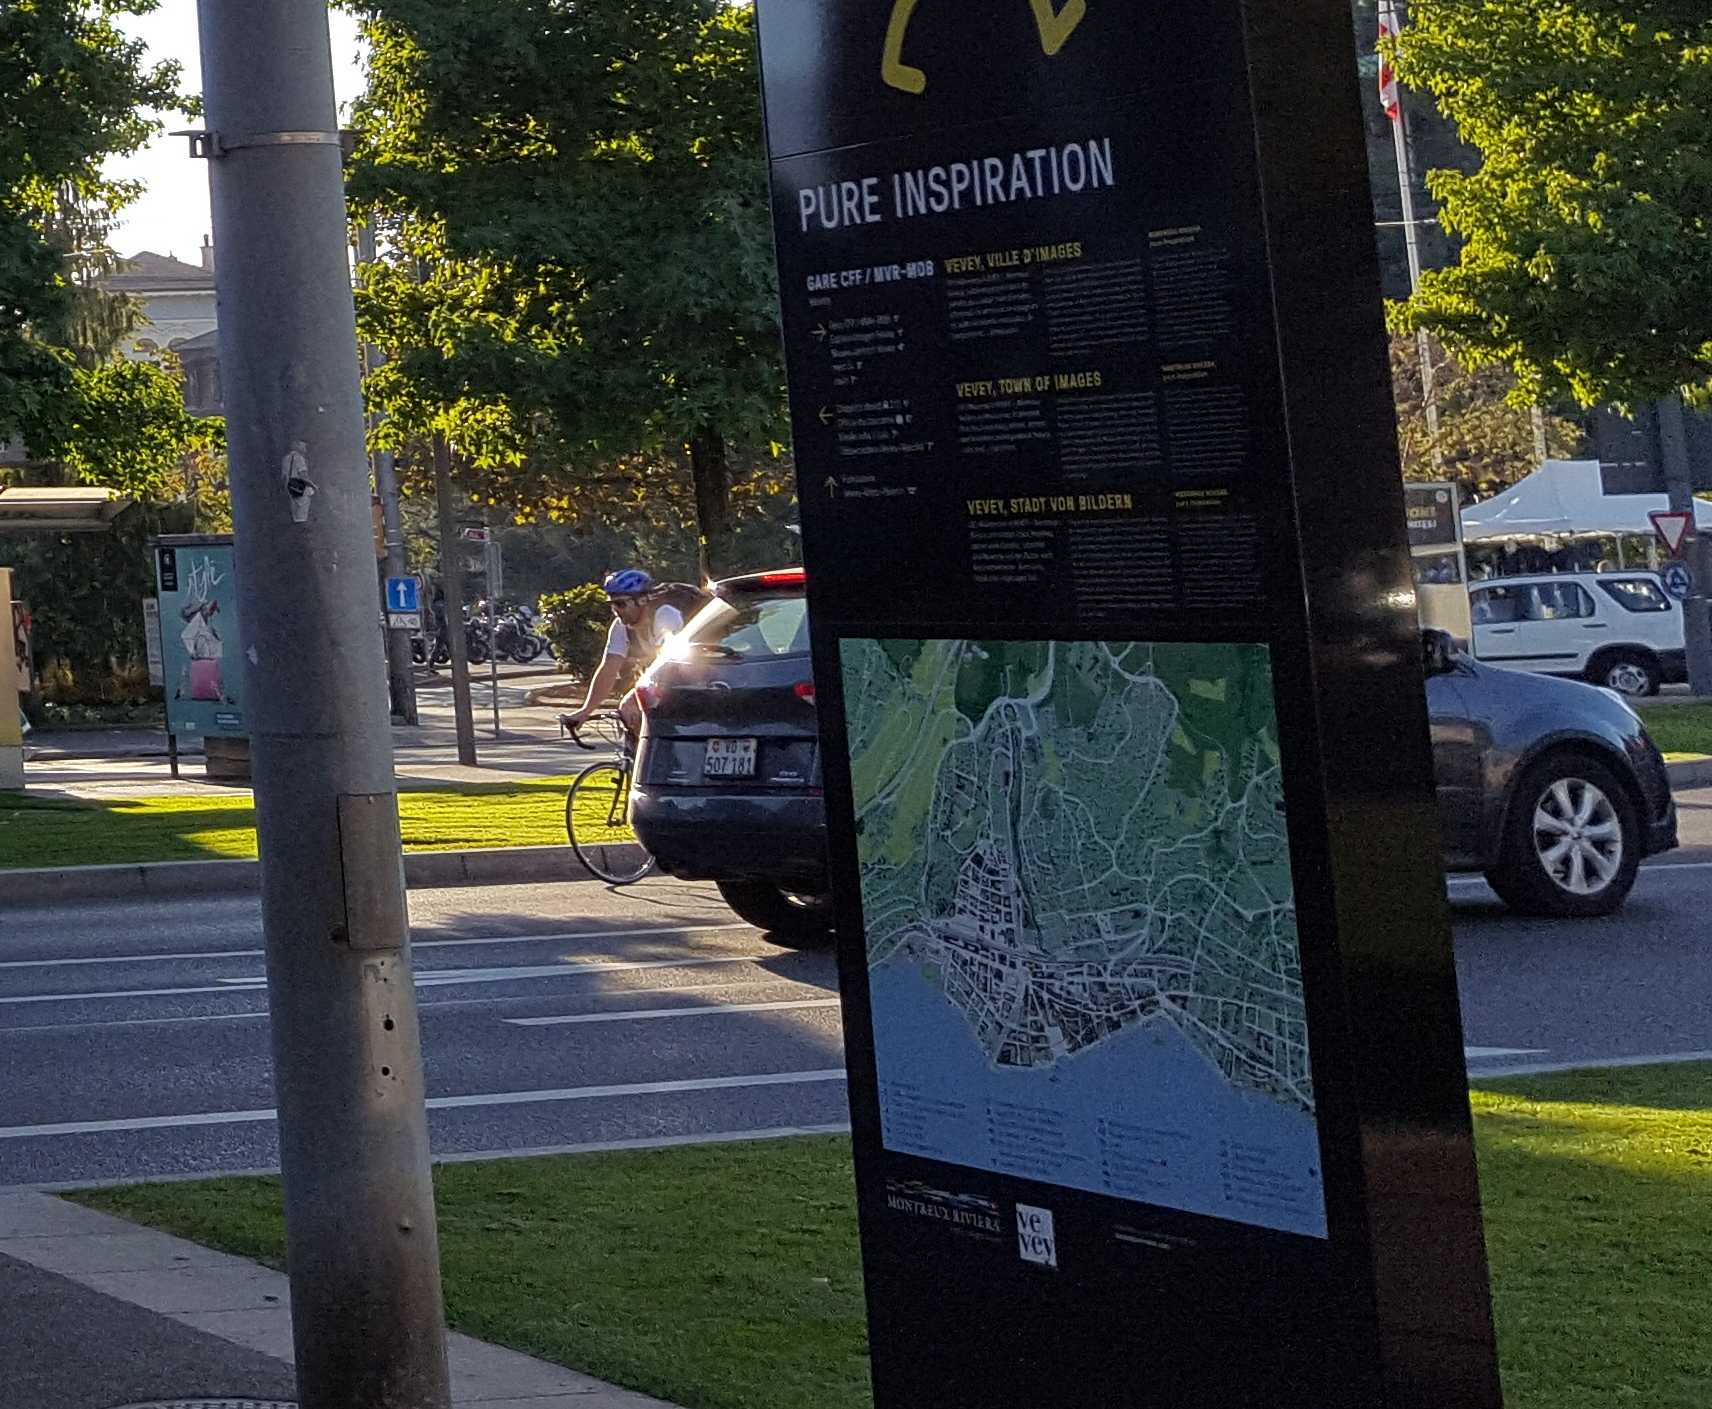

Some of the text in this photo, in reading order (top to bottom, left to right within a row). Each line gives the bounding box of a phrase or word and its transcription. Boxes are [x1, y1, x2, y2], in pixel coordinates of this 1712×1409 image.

[799, 137, 1116, 232] PURE INSPIRATION
[944, 242, 1083, 274] VEVEY, VILLE D'IMAGES
[806, 272, 839, 291] GARE
[840, 269, 864, 287] CFF
[956, 371, 1103, 398] VEVEY, TOWN OF IMAGES
[967, 493, 1133, 516] VEVEY, STADT VON BILDERN
[886, 1193, 1001, 1232] MONTREUX RIVIERA
[1017, 1211, 1042, 1232] ve
[1019, 1232, 1054, 1266] vey
